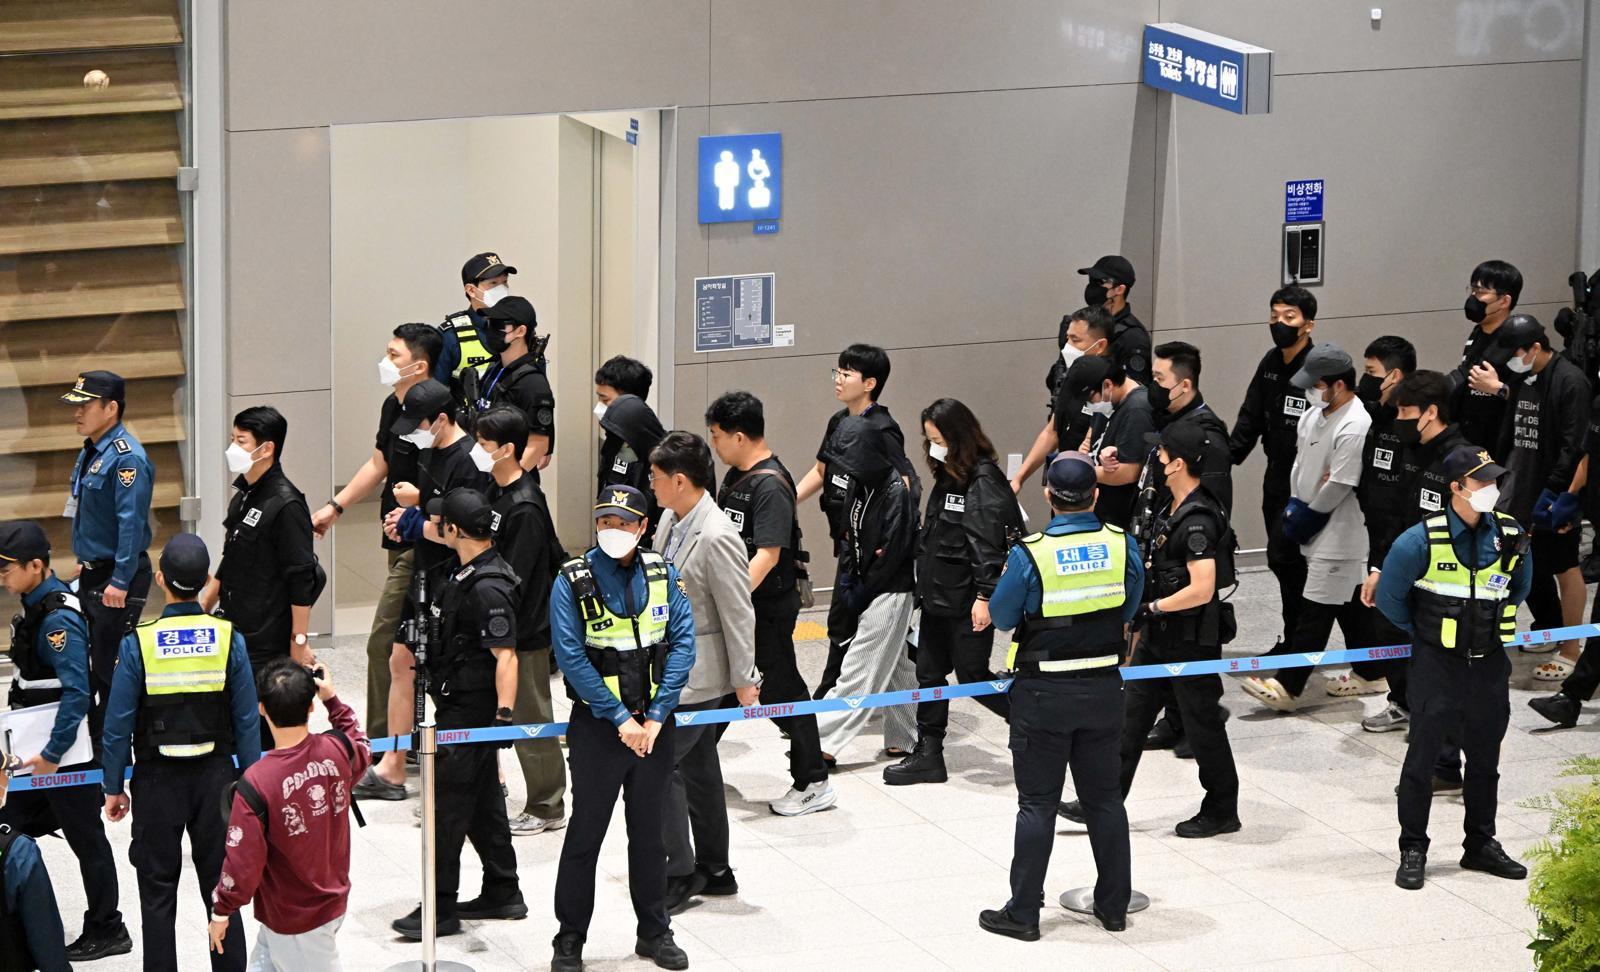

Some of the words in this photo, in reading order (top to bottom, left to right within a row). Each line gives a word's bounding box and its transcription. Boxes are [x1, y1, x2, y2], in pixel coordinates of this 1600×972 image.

[1185, 55, 1217, 89] 화장실
[1287, 182, 1322, 196] 비상전화
[1061, 560, 1107, 573] POLICE
[163, 645, 212, 656] POLICE
[743, 704, 795, 719] SECURITY
[30, 772, 87, 787] SECURITY
[282, 759, 340, 800] COLOUR
